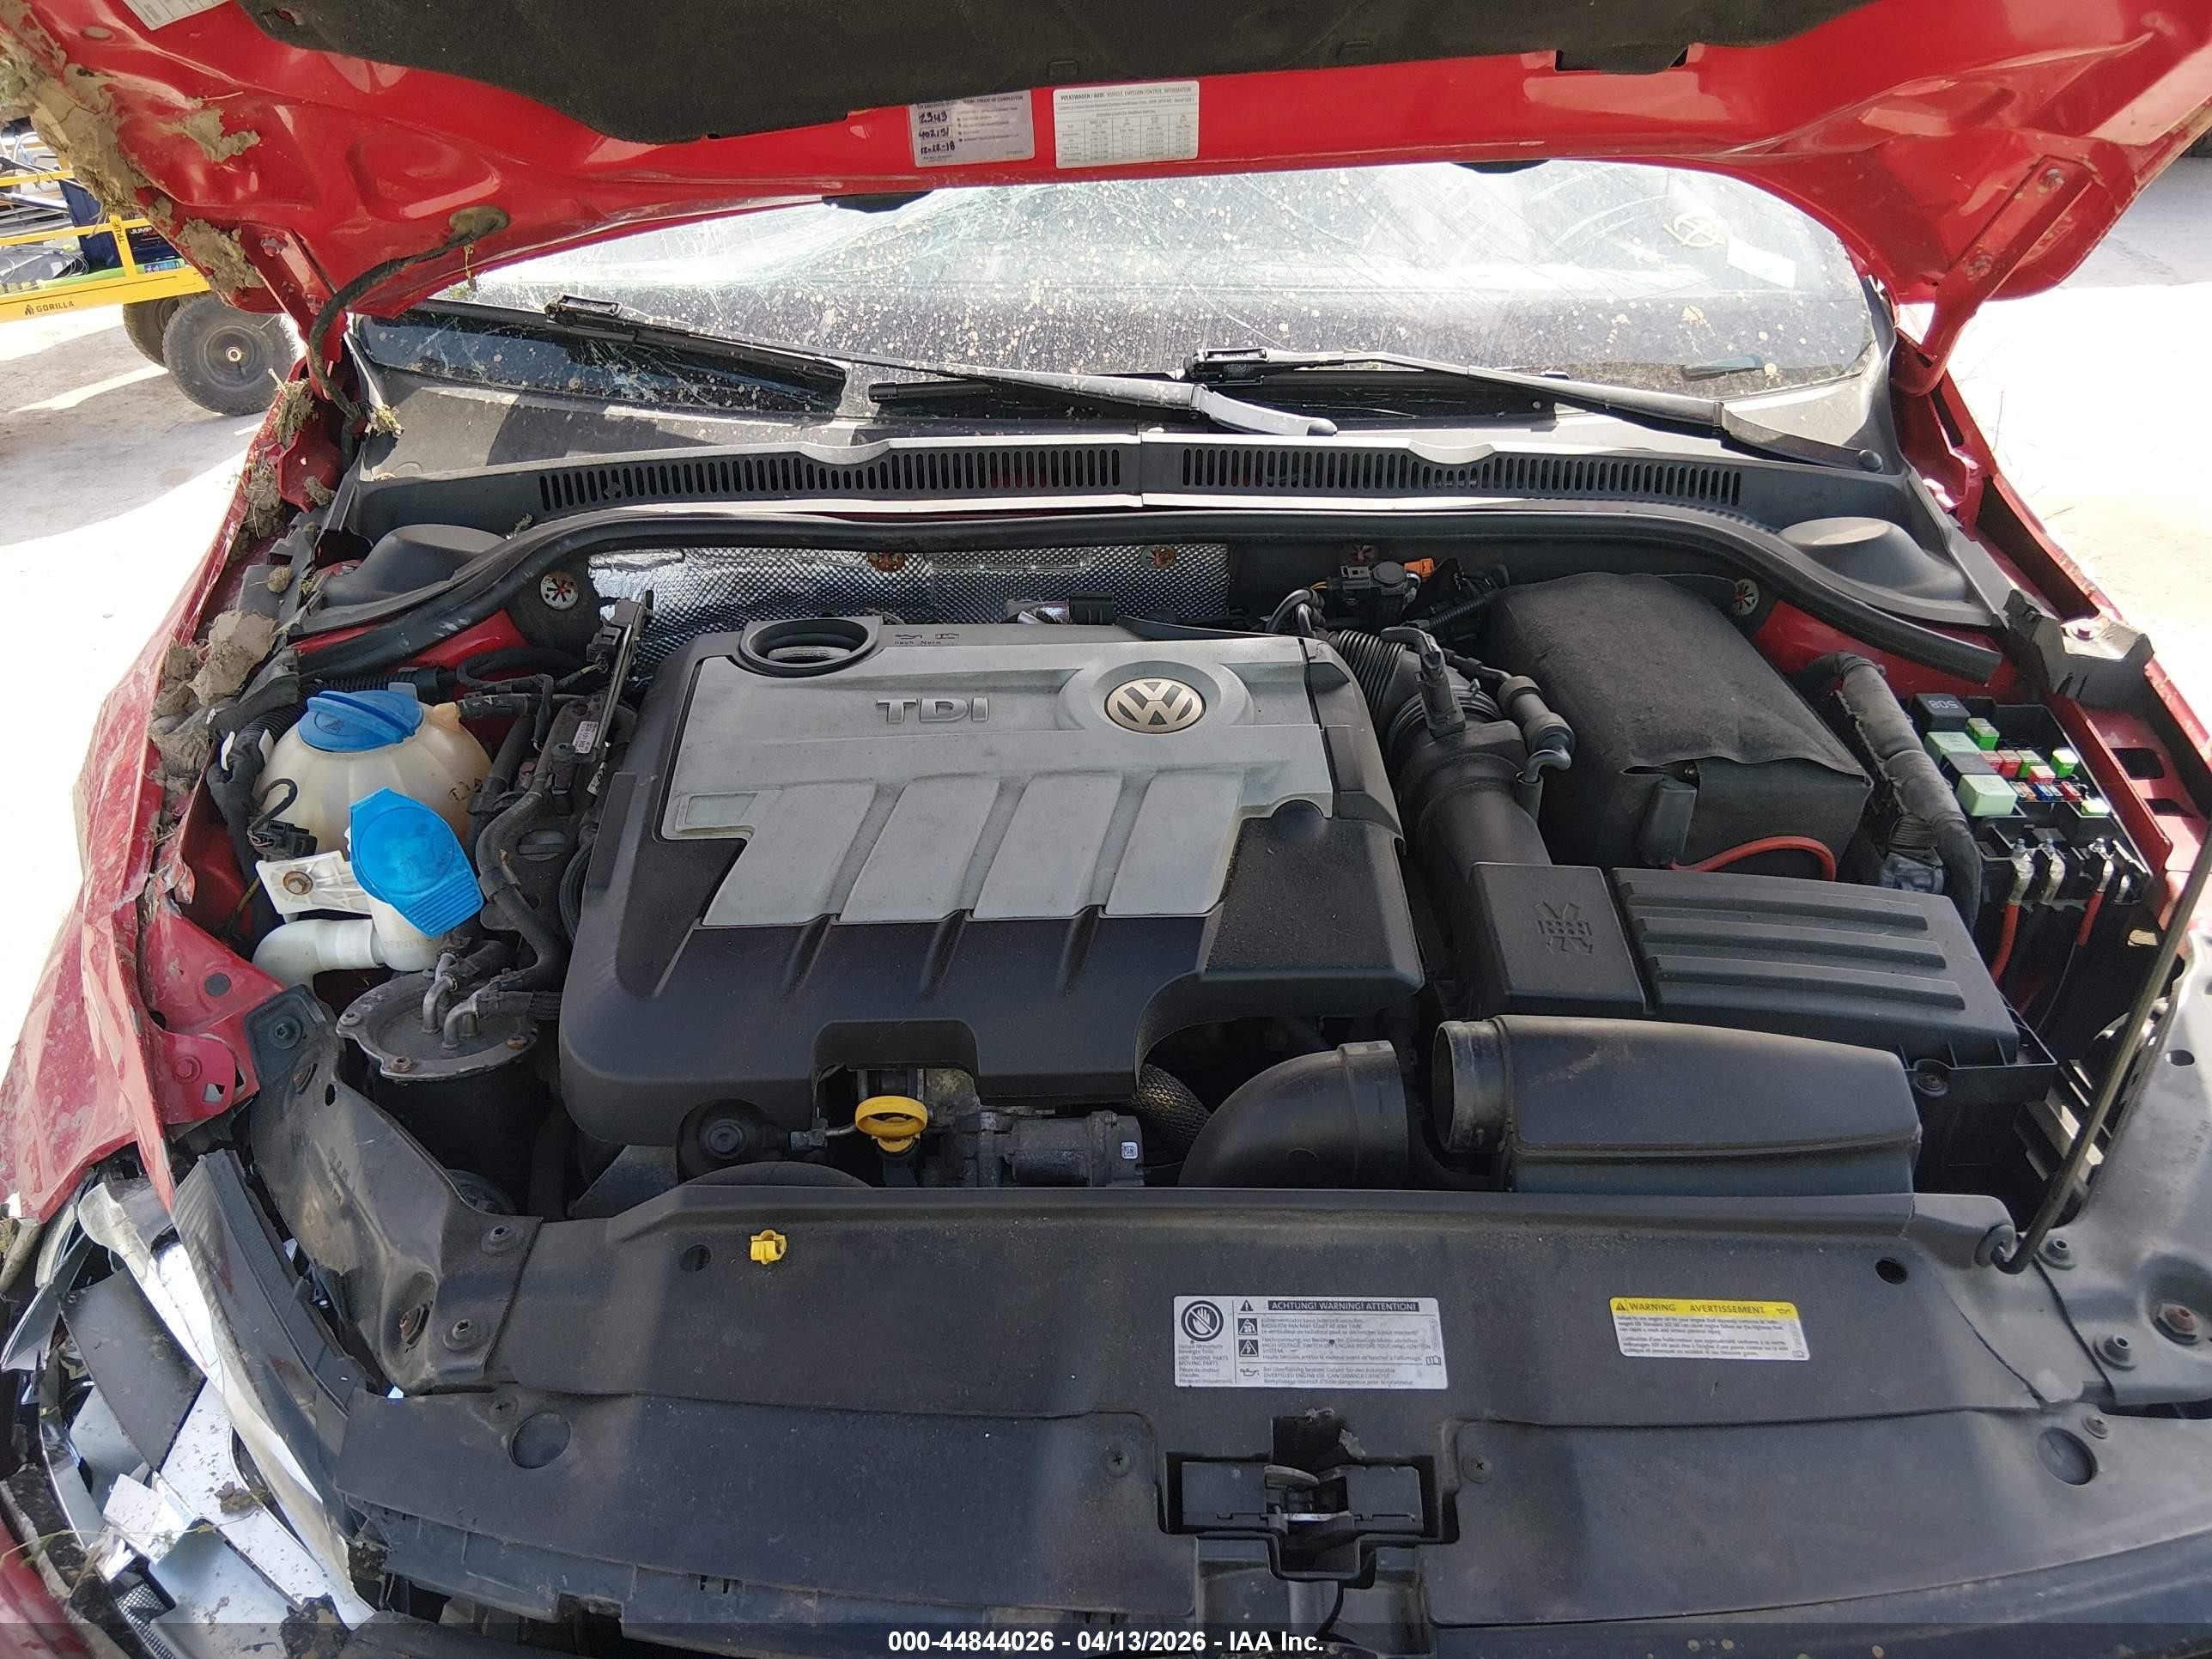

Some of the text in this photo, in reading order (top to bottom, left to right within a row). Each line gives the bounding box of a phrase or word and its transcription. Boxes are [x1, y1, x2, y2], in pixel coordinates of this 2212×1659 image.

[36, 301, 75, 313] GORILLA
[876, 697, 988, 724] TDI
[1272, 1302, 1418, 1312] ACHTUNG! WARNING! ATTENTION!
[1630, 1302, 1765, 1315] WARNING AVERTISSEMENT
